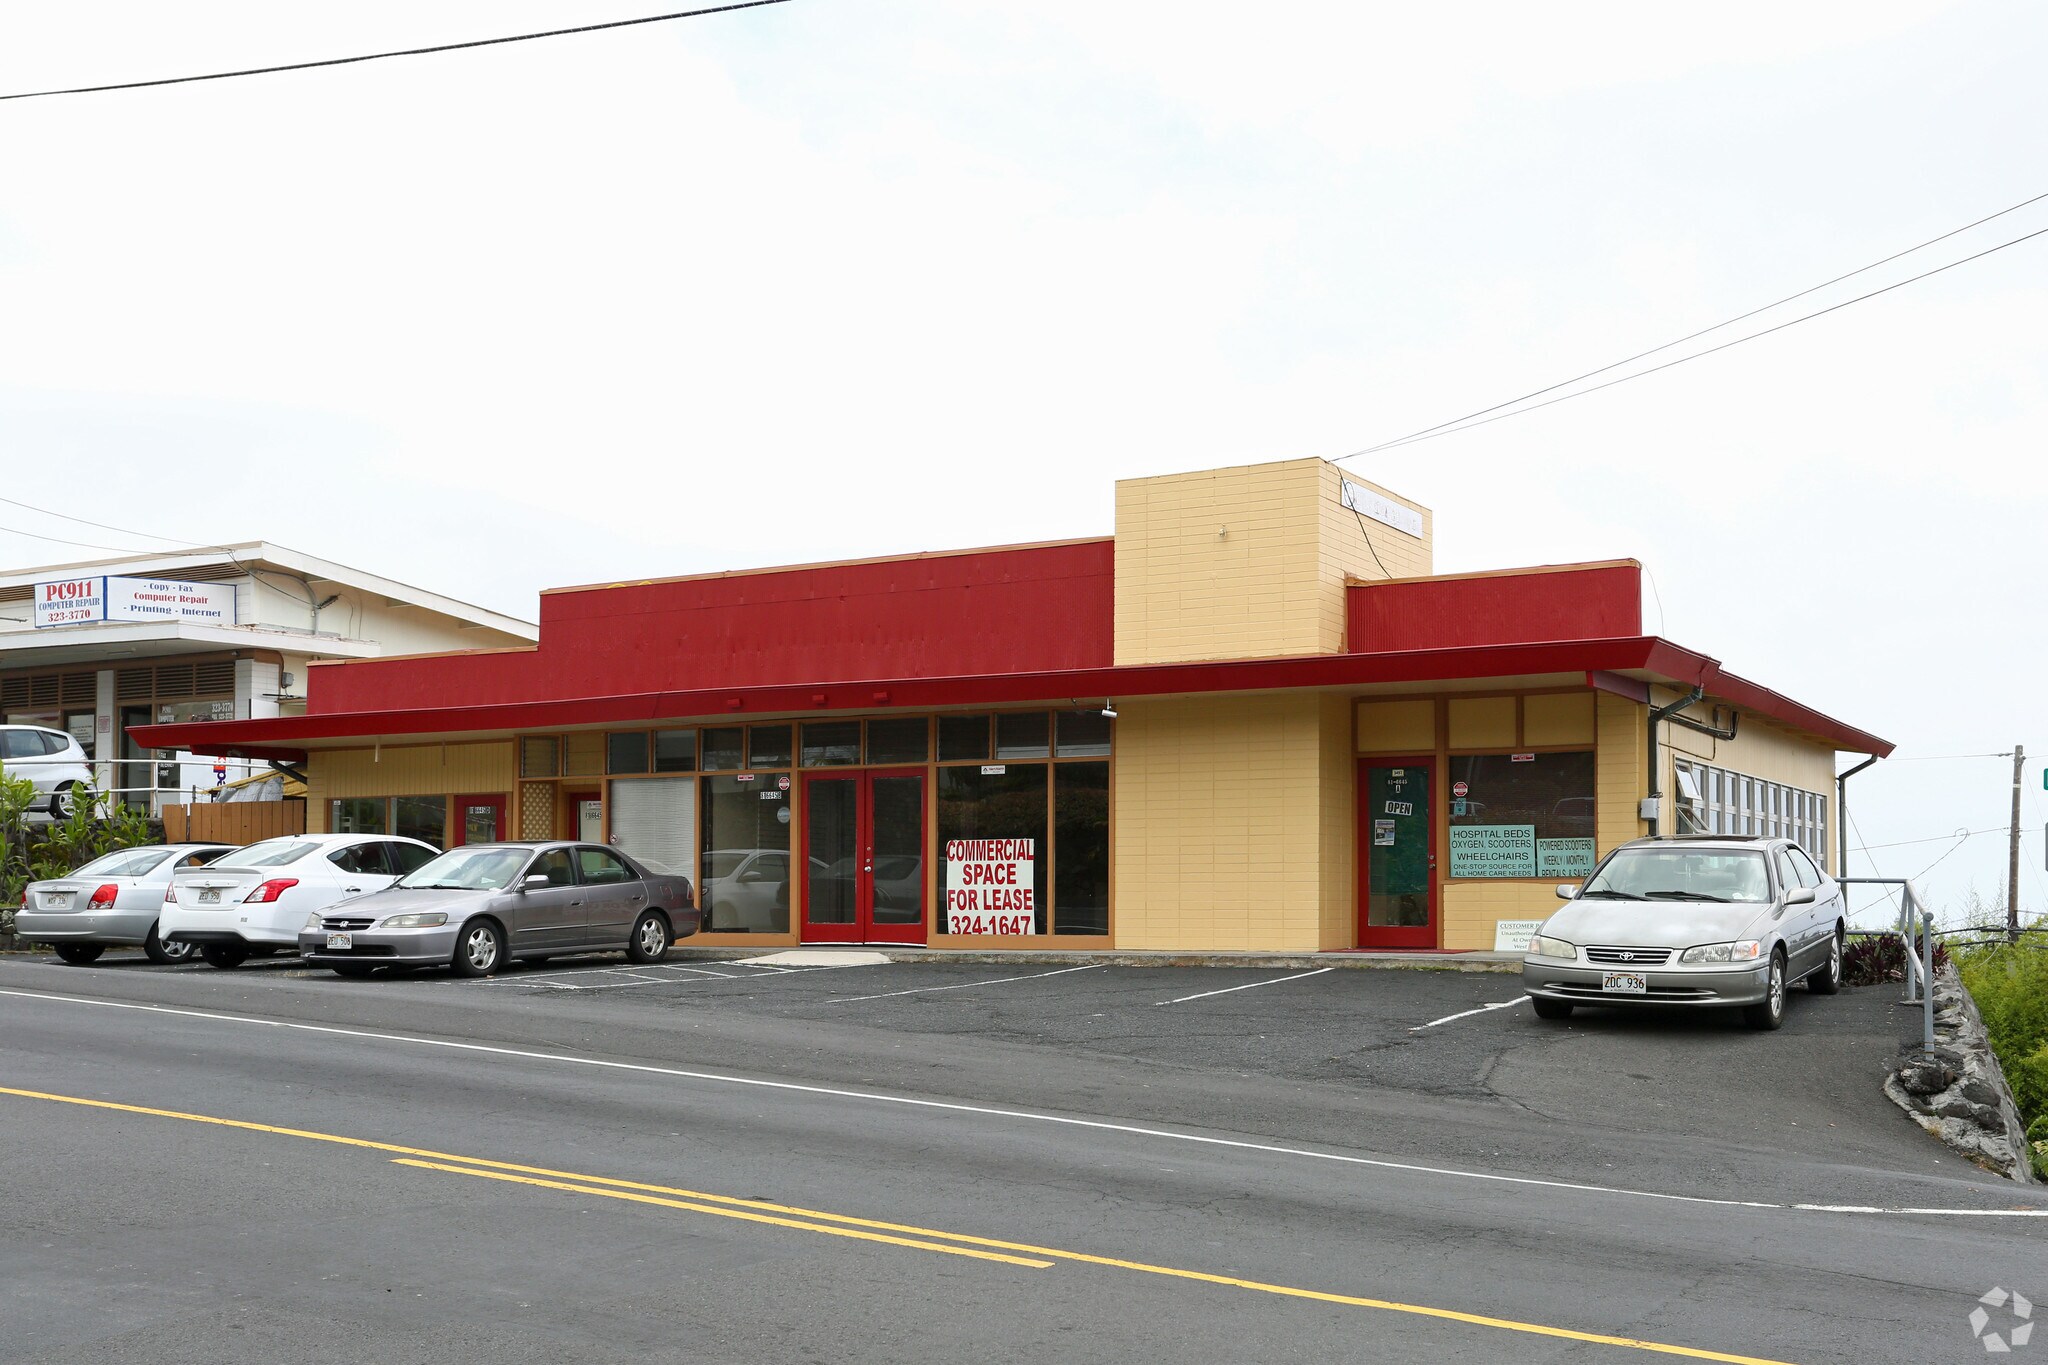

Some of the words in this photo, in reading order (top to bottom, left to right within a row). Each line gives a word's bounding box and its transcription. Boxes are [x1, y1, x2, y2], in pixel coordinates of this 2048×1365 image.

[46, 581, 93, 601] PC911
[149, 583, 170, 592] Copy
[178, 584, 194, 593] Fax
[39, 601, 74, 611] COMPUTER
[75, 598, 100, 608] REPAIR
[134, 592, 176, 602] Computer
[179, 595, 209, 604] Repair
[48, 610, 91, 622] 323-3770
[130, 605, 172, 615] Printing
[181, 607, 221, 618] Internet
[1387, 802, 1411, 815] OPEN
[1453, 830, 1500, 838] HOSPITAL
[1504, 829, 1531, 838] BEDS
[947, 839, 1035, 861] COMMERCIAL
[1540, 841, 1564, 851] POWERED
[1564, 840, 1592, 850] SCOOTERS
[1457, 852, 1529, 861] WHEELCHAIRS
[1543, 855, 1562, 866] WEEKLY
[1566, 855, 1589, 865] MONTHLY
[962, 863, 1017, 885] SPACE
[947, 889, 978, 911] FOR
[983, 889, 1033, 911] LEASE
[950, 915, 1031, 935] 324-1647
[1604, 976, 1622, 989] ZDC
[1627, 977, 1645, 989] 936
